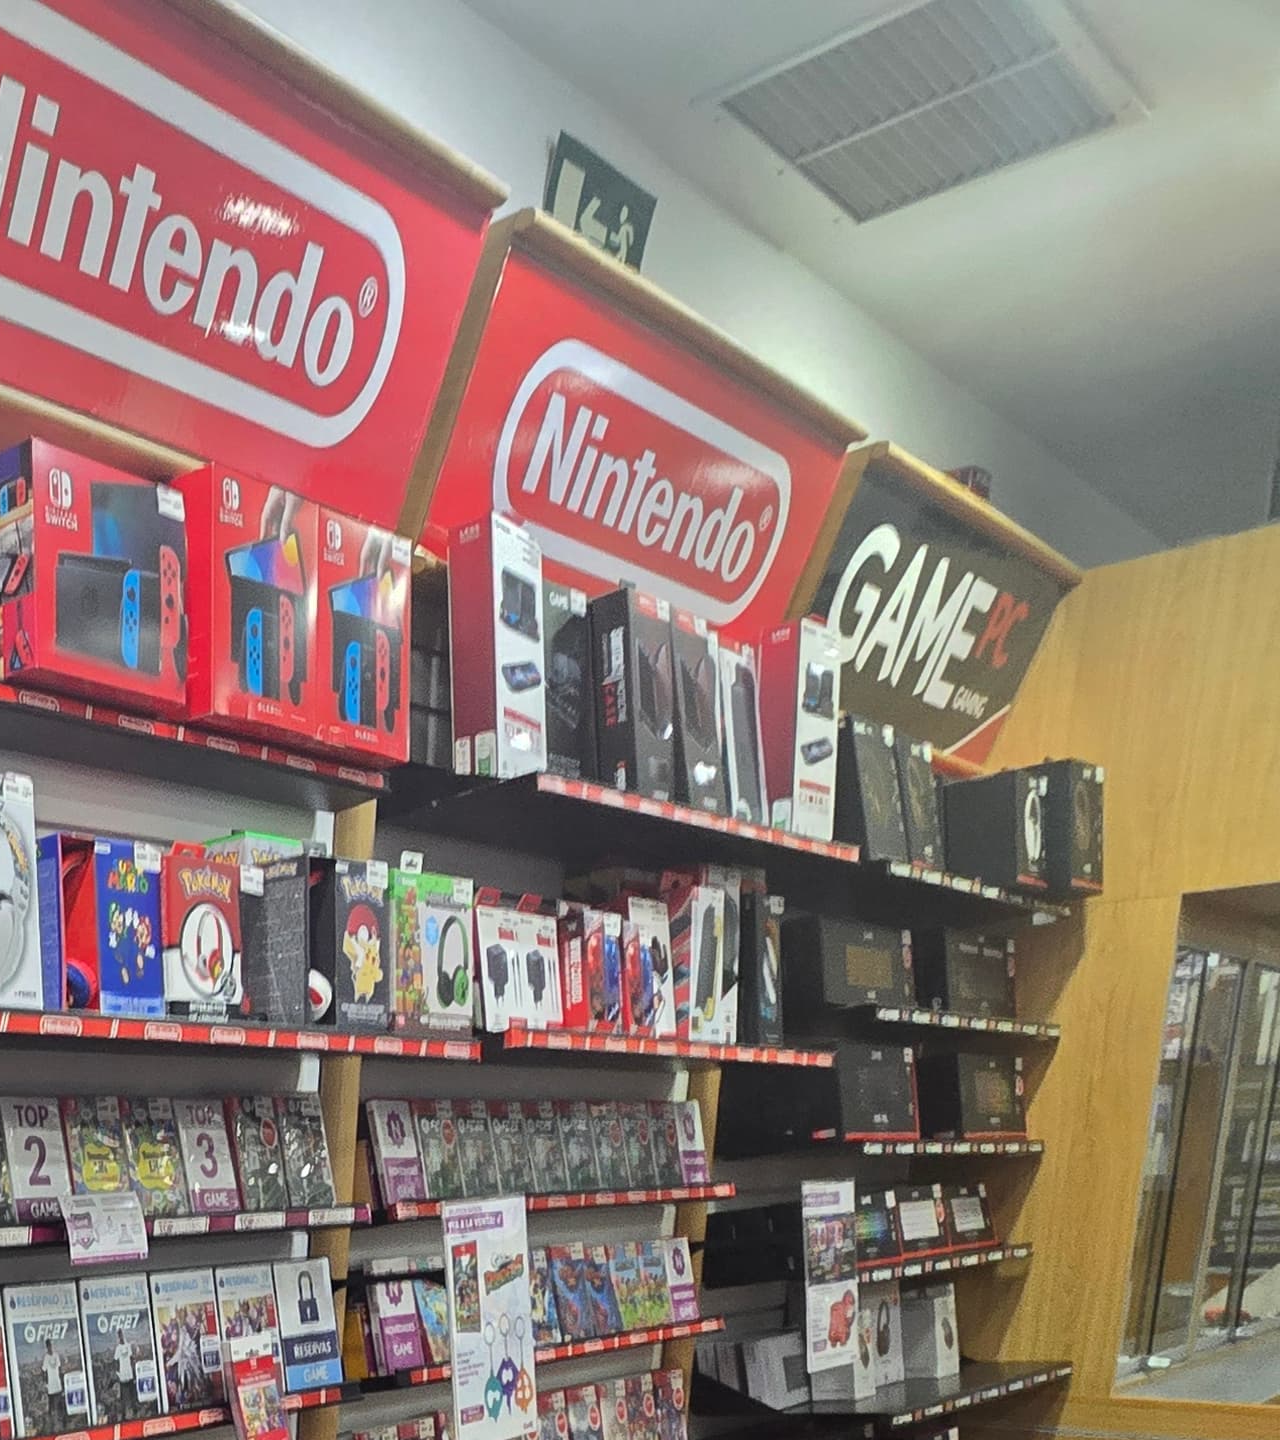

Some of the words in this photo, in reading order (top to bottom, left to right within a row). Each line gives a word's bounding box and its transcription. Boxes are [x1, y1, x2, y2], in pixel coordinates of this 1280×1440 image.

[827, 523, 998, 709] GAME
[14, 1103, 49, 1128] TOP
[24, 1135, 51, 1186] 2
[196, 1132, 218, 1179] 3
